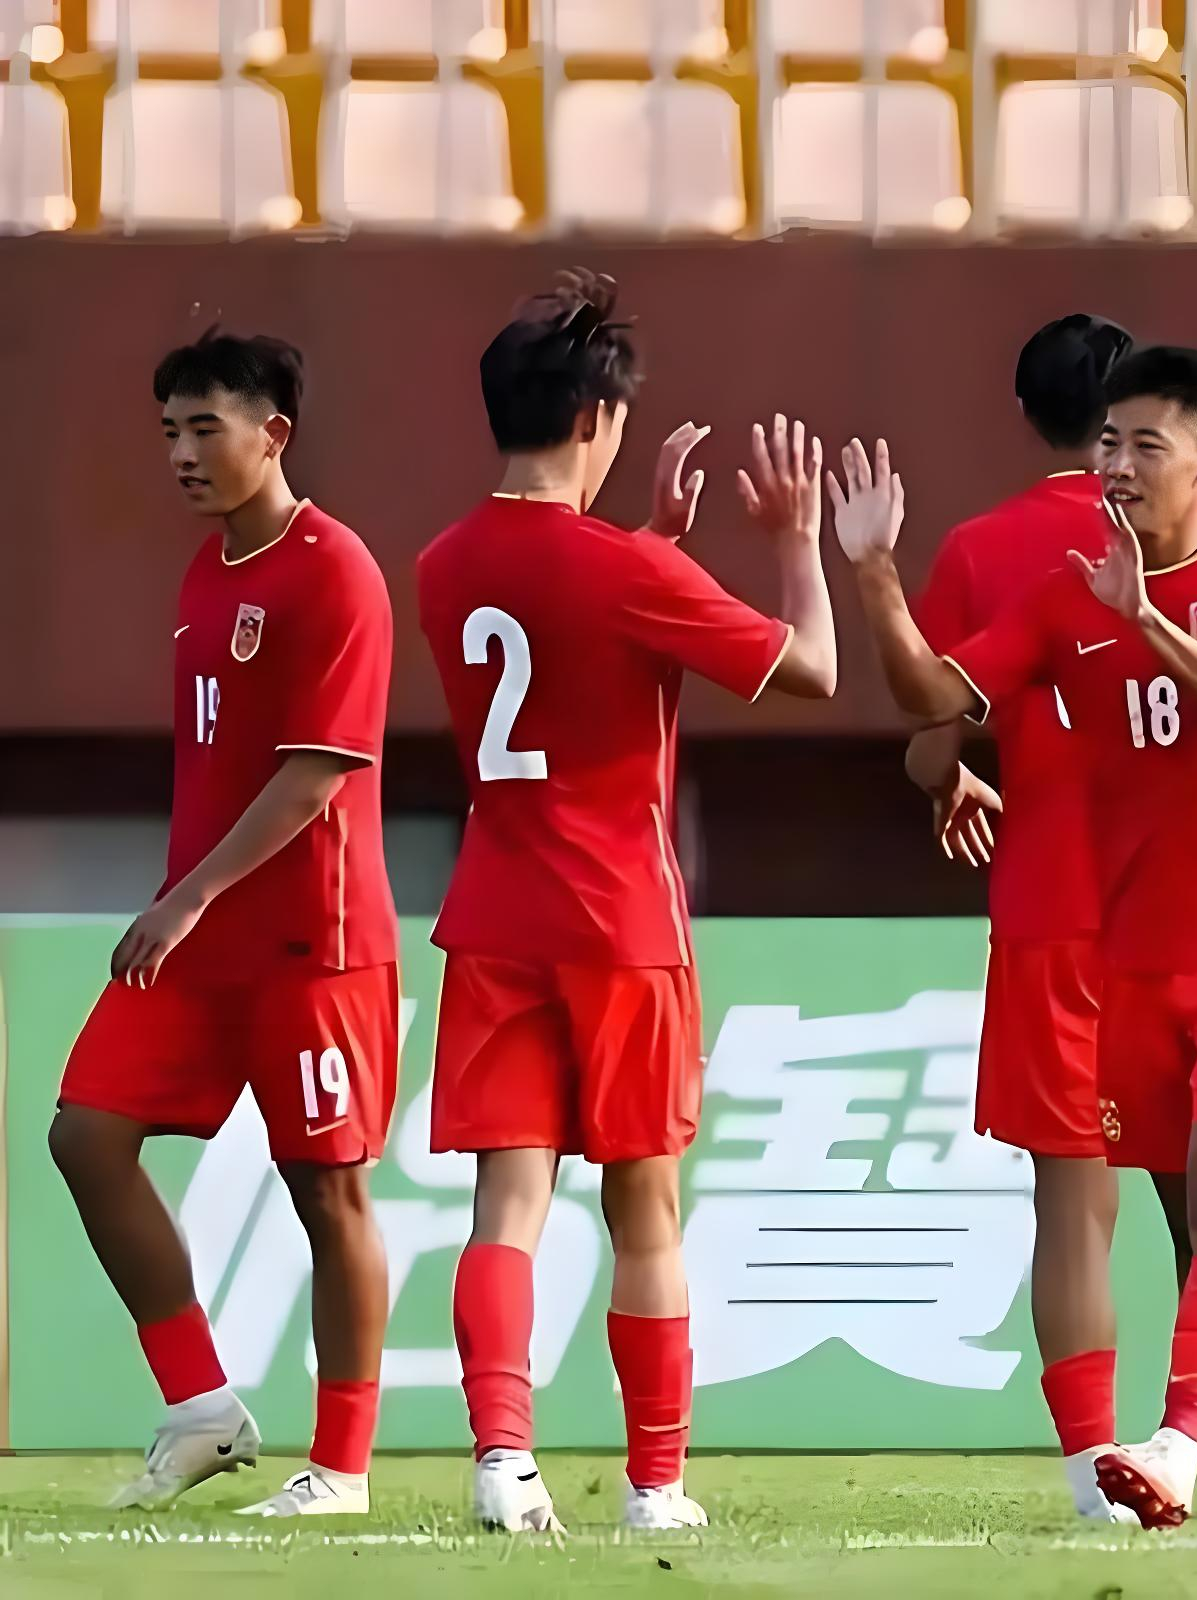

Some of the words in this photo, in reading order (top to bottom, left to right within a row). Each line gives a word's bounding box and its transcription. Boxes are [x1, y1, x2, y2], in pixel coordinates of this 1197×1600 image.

[462, 606, 548, 782] 2
[1126, 675, 1180, 749] 18
[299, 1046, 350, 1119] 19
